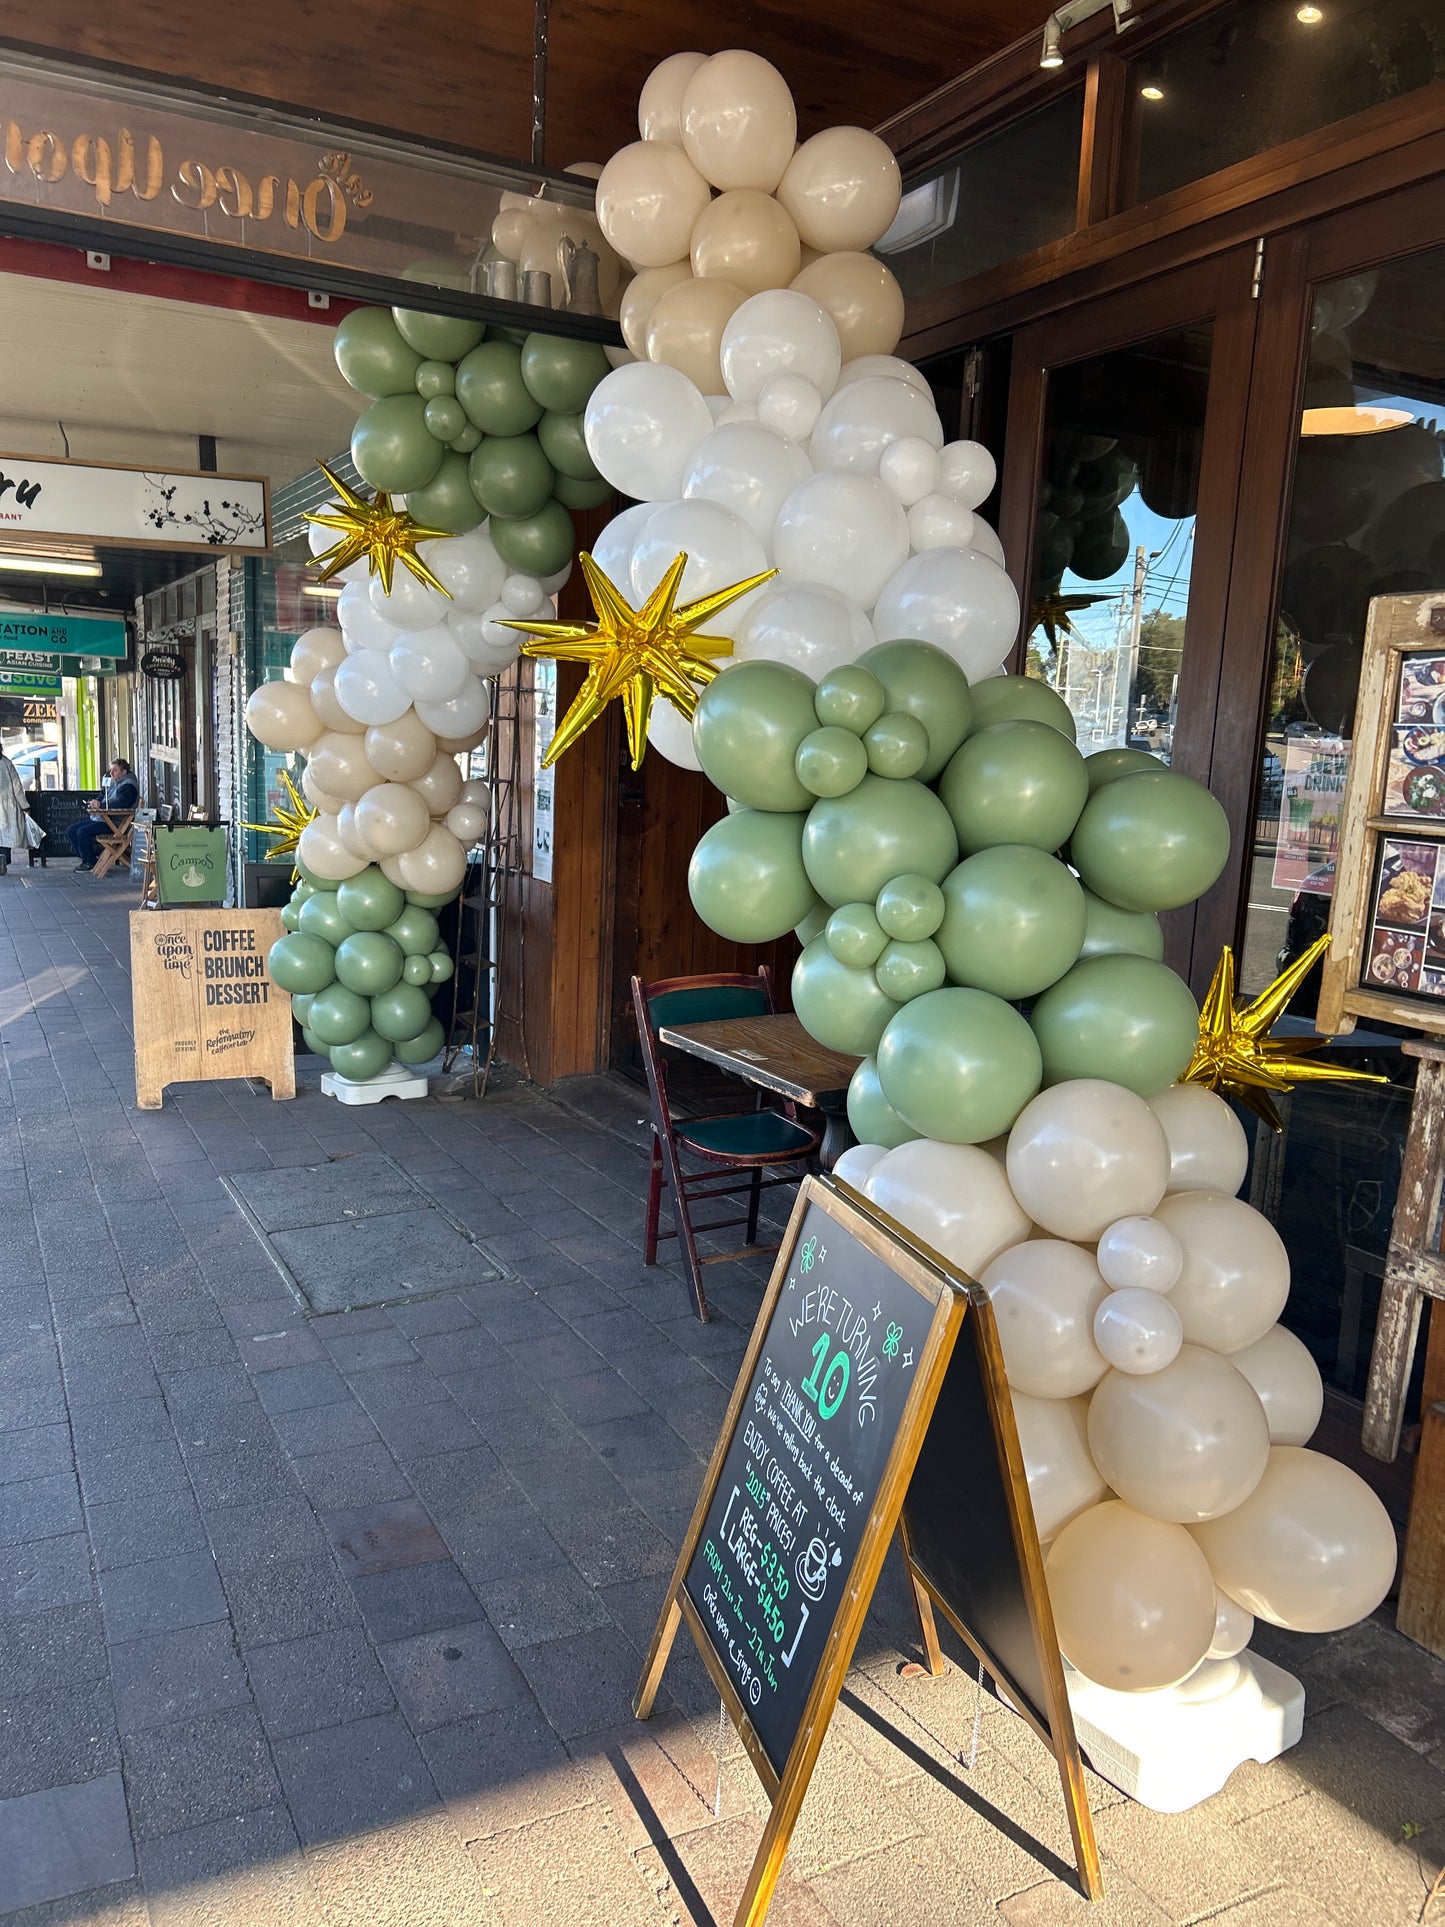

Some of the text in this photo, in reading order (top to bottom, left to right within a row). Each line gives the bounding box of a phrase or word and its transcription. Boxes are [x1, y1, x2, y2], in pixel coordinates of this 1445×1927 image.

[6, 651, 54, 662] FEAST
[51, 635, 68, 644] CO
[154, 928, 188, 946] Once
[156, 945, 195, 959] upon
[203, 929, 256, 952] COFFEE
[162, 957, 193, 979] time
[204, 955, 264, 979] BRUNCH
[206, 982, 270, 1006] DESSERT
[206, 1030, 256, 1051] Reformatory
[789, 1284, 878, 1428] WE'RE TURNING
[801, 1332, 850, 1420] 10
[764, 1357, 864, 1506] To say THANK YOU for a decade of
[743, 1420, 808, 1527] ENJOY COFFEE AT
[782, 1430, 800, 1462] rolling
[798, 1451, 813, 1481] back
[814, 1475, 826, 1501] the
[826, 1496, 846, 1532] clock.
[765, 1502, 797, 1556] PRICES!
[761, 1542, 789, 1600] $3.50
[703, 1539, 724, 1583] FROM
[763, 1653, 778, 1692] Jun
[703, 1583, 718, 1618] Once
[715, 1611, 729, 1640] upon
[736, 1649, 752, 1686] time
[758, 1583, 785, 1643] $4.50
